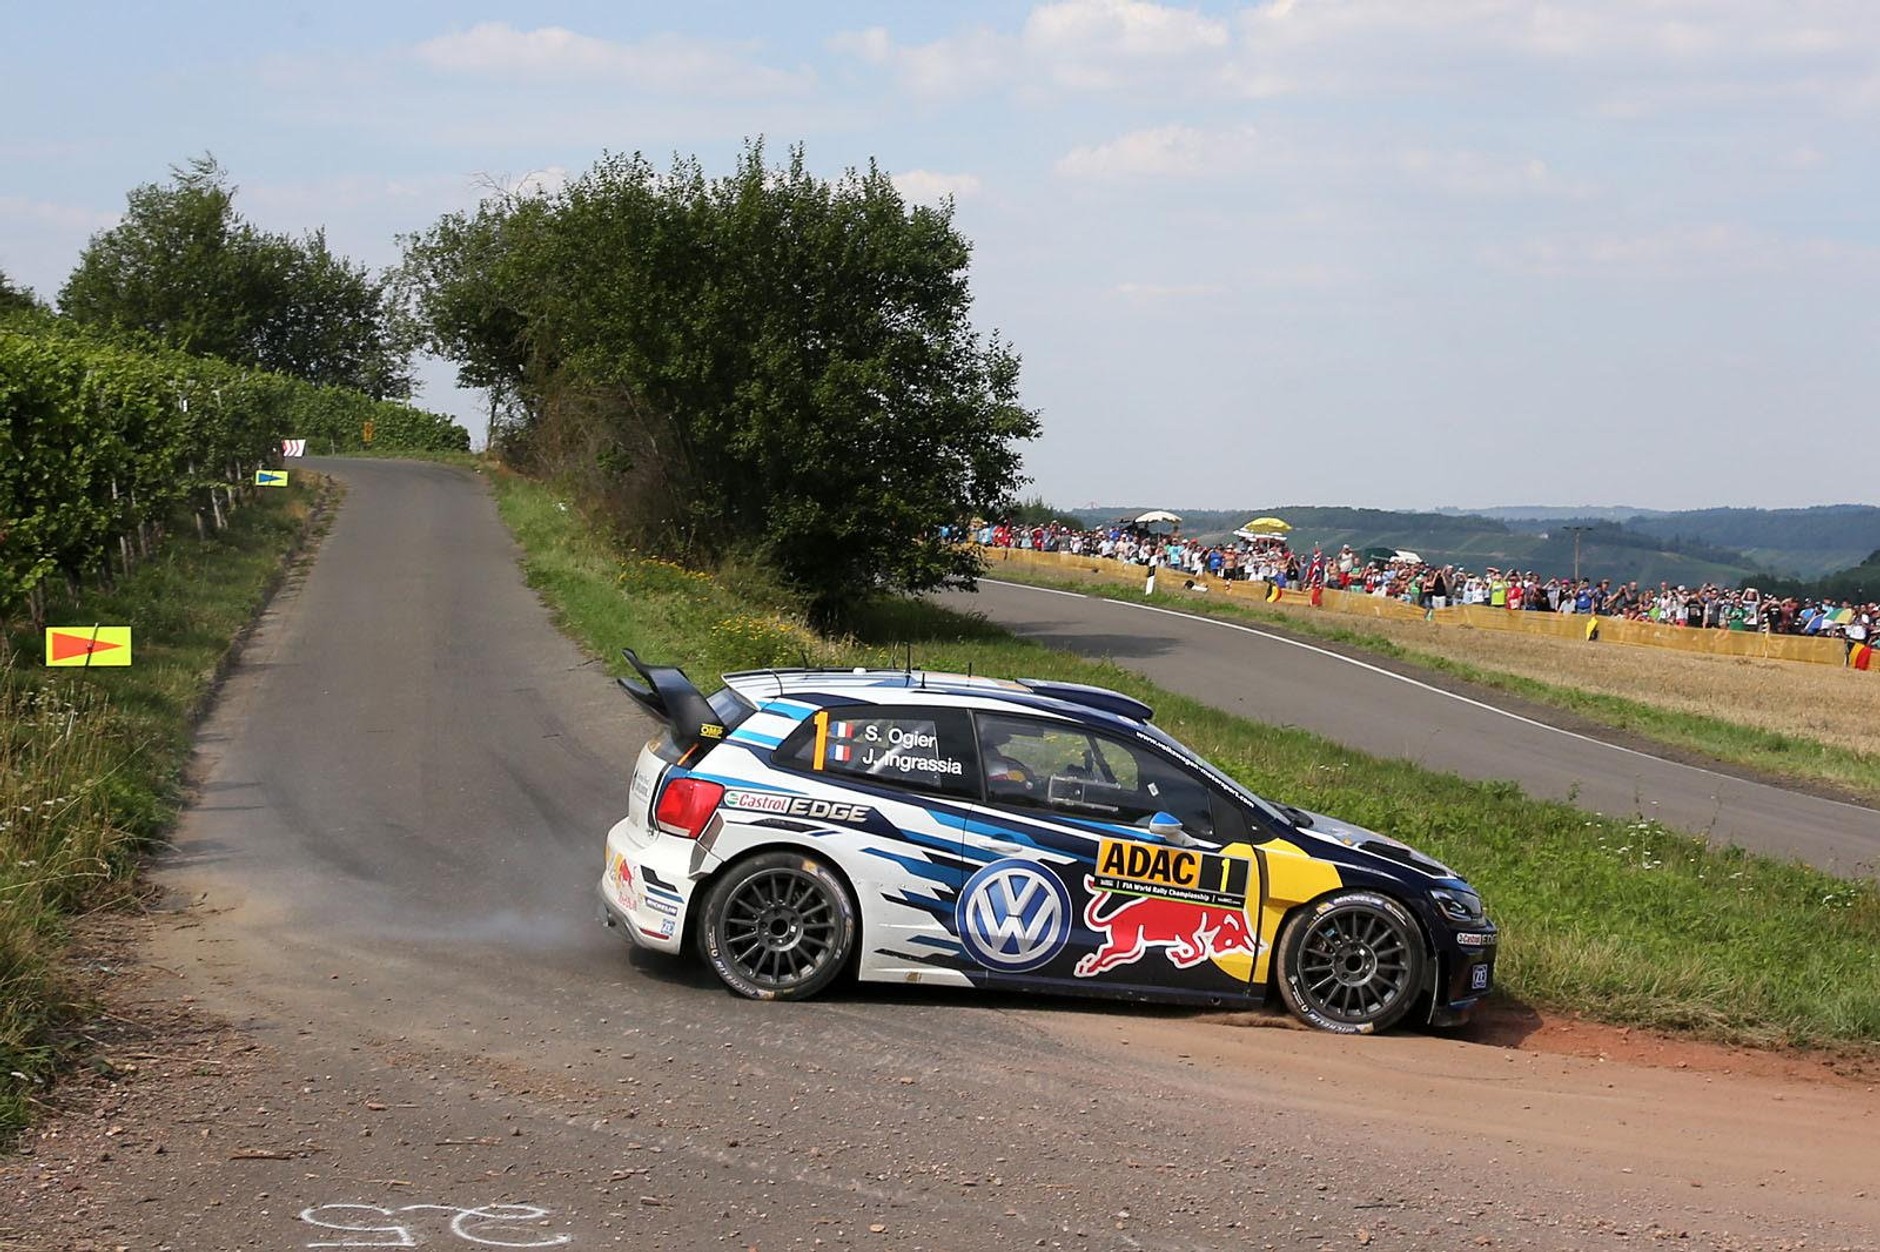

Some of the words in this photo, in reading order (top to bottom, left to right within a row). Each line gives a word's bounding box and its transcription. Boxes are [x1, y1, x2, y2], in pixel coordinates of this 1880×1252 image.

[813, 711, 828, 771] 1
[865, 725, 882, 742] S.
[888, 727, 937, 749] Ogier
[862, 749, 877, 765] J.
[884, 751, 962, 775] Ingrassia
[738, 794, 788, 812] Castrol
[790, 800, 870, 823] EDGE
[1102, 842, 1196, 885] ADAC
[1220, 858, 1231, 893] 1
[1122, 881, 1133, 890] FIA
[1134, 883, 1151, 893] World
[1152, 886, 1167, 896] Rally
[1169, 888, 1210, 902] Championship
